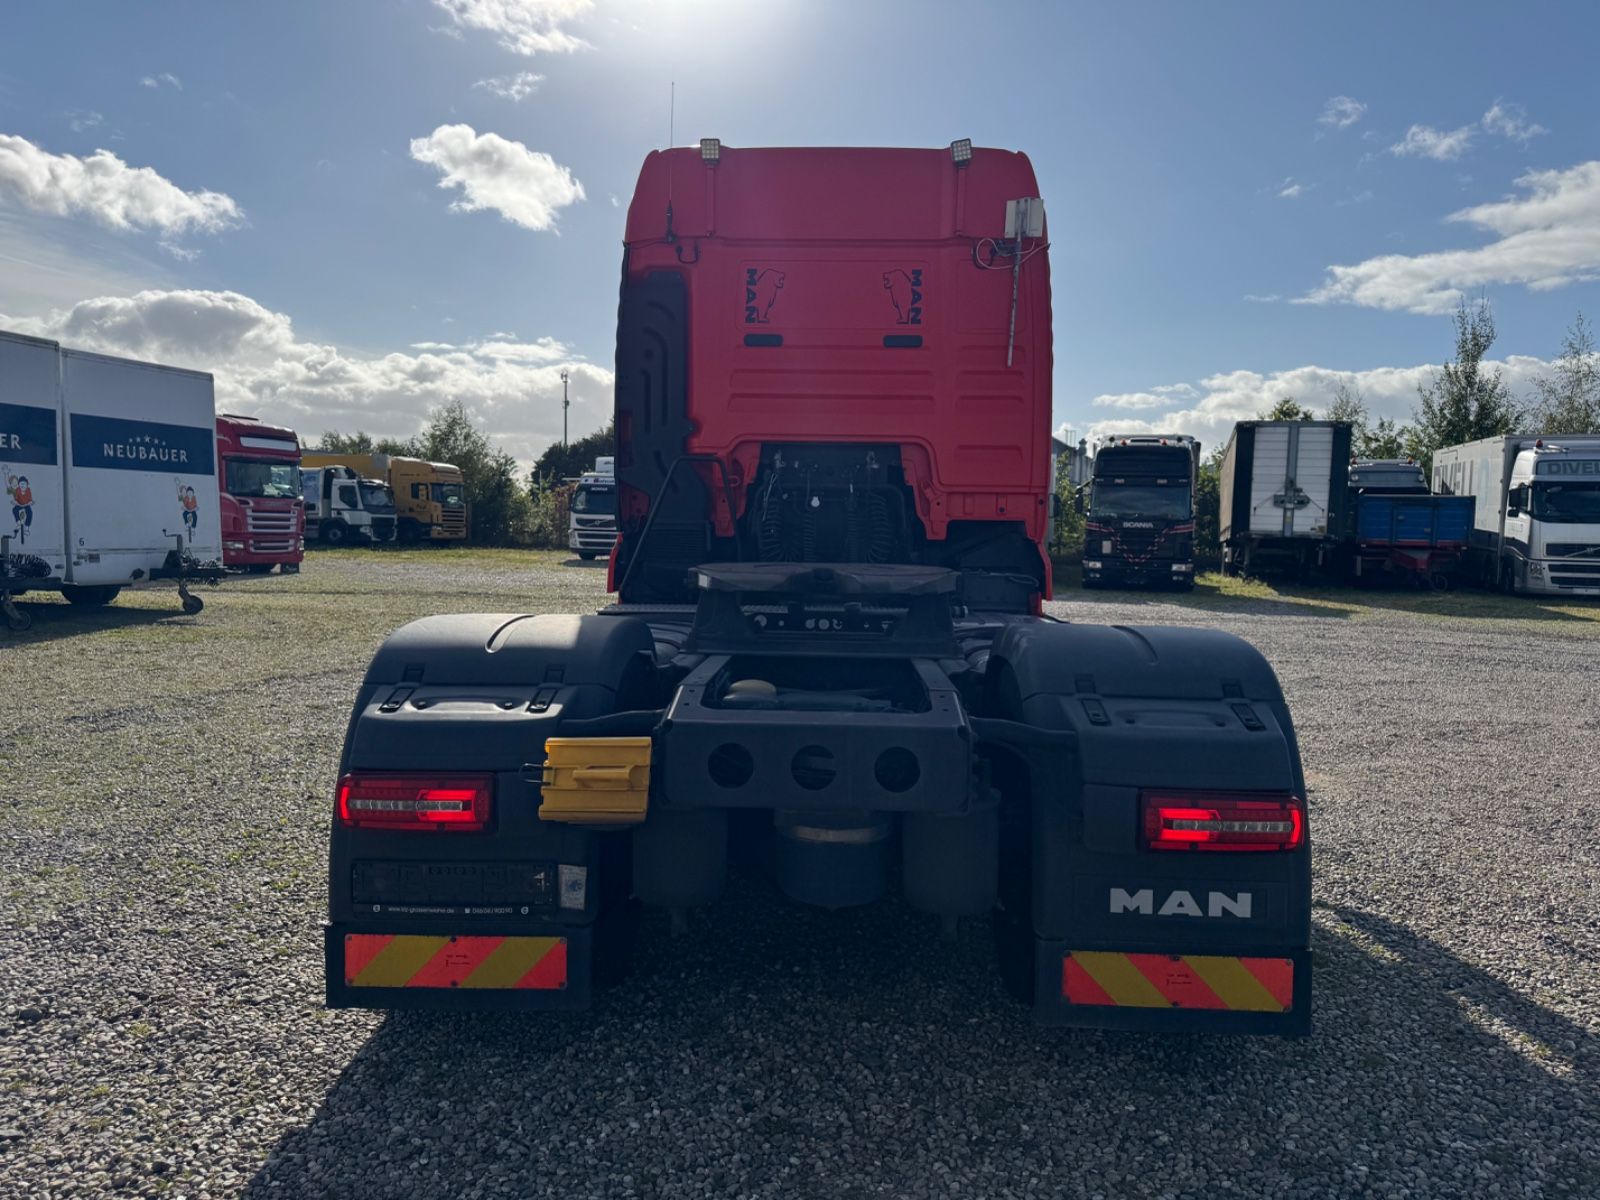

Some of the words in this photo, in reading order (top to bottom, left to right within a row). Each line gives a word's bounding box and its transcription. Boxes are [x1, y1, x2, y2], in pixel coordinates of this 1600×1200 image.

[744, 268, 758, 324] MAN
[910, 268, 923, 325] MAN
[0, 433, 22, 450] ER
[103, 442, 189, 464] NEUBAUER
[1122, 521, 1154, 529] SCANIA
[78, 537, 85, 546] 6
[1109, 887, 1252, 918] MAN
